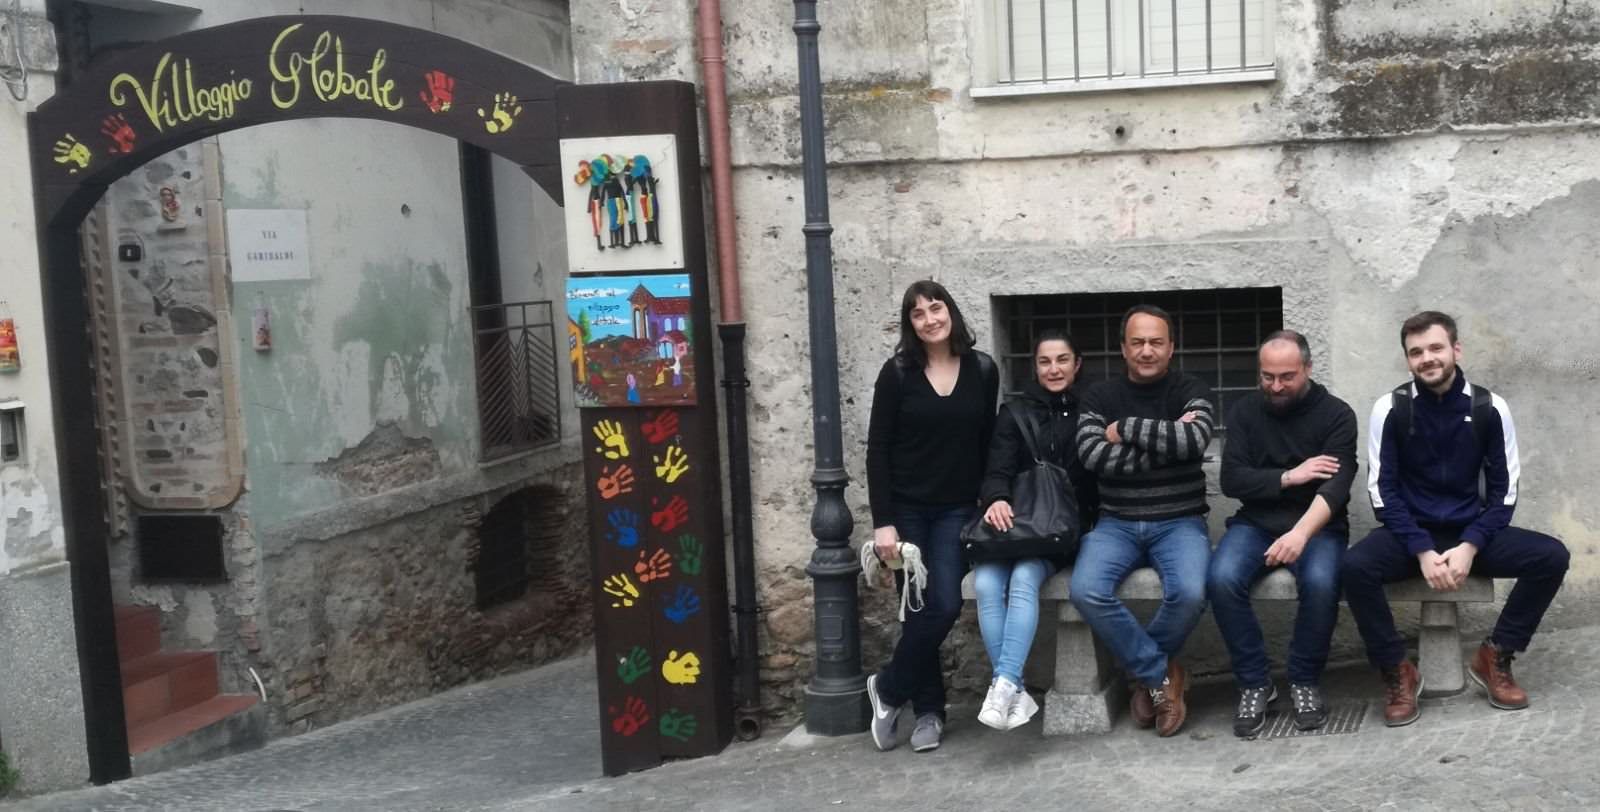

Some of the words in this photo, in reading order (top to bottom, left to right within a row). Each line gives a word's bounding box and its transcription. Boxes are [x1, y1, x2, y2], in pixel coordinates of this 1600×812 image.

[110, 53, 252, 132] Villaggio
[269, 24, 403, 110] Globale
[261, 231, 277, 239] VIA
[247, 251, 294, 261] GARIBALDI
